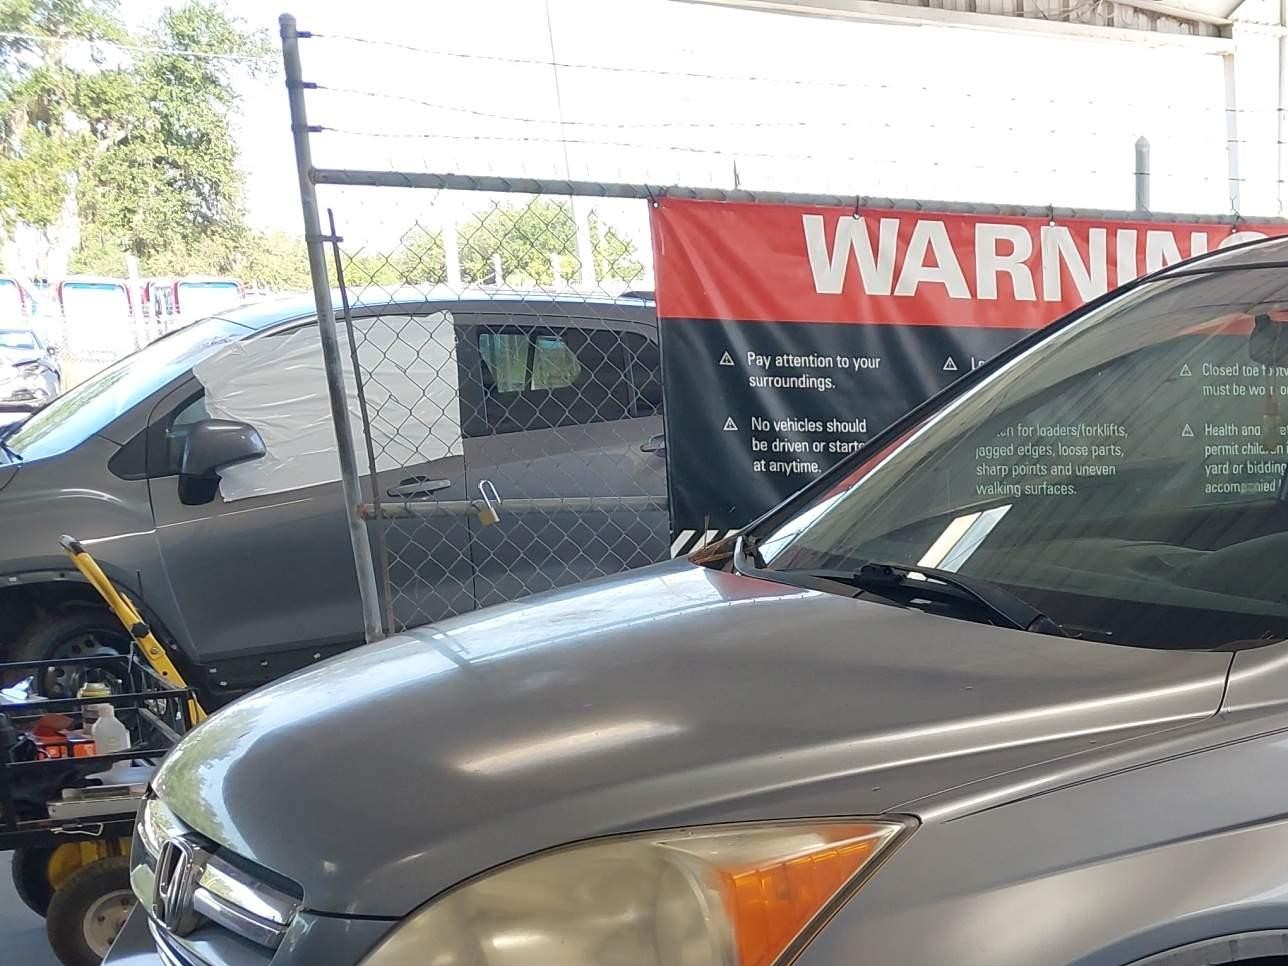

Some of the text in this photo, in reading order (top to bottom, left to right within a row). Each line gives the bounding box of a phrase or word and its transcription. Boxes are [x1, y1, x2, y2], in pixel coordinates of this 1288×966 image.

[802, 214, 1269, 301] WARNI
[747, 352, 880, 371] Pay attention to your
[1202, 363, 1239, 376] Closed
[1242, 365, 1259, 376] toe
[749, 374, 836, 391] surroundings.
[1202, 384, 1230, 396] must
[1233, 384, 1246, 396] be
[751, 416, 866, 433] No vehicles should
[1018, 424, 1033, 437] for
[1204, 424, 1238, 436] Health
[752, 438, 865, 453] be driven or start
[976, 442, 1124, 460] jagged edges, loose parts,
[1204, 444, 1239, 458] permit
[1241, 442, 1284, 455] chiln
[753, 460, 822, 476] at anytime.
[976, 462, 1116, 478] sharp points and uneven
[1204, 460, 1288, 477] yard or bidding
[976, 482, 1077, 497] walking surfaces.
